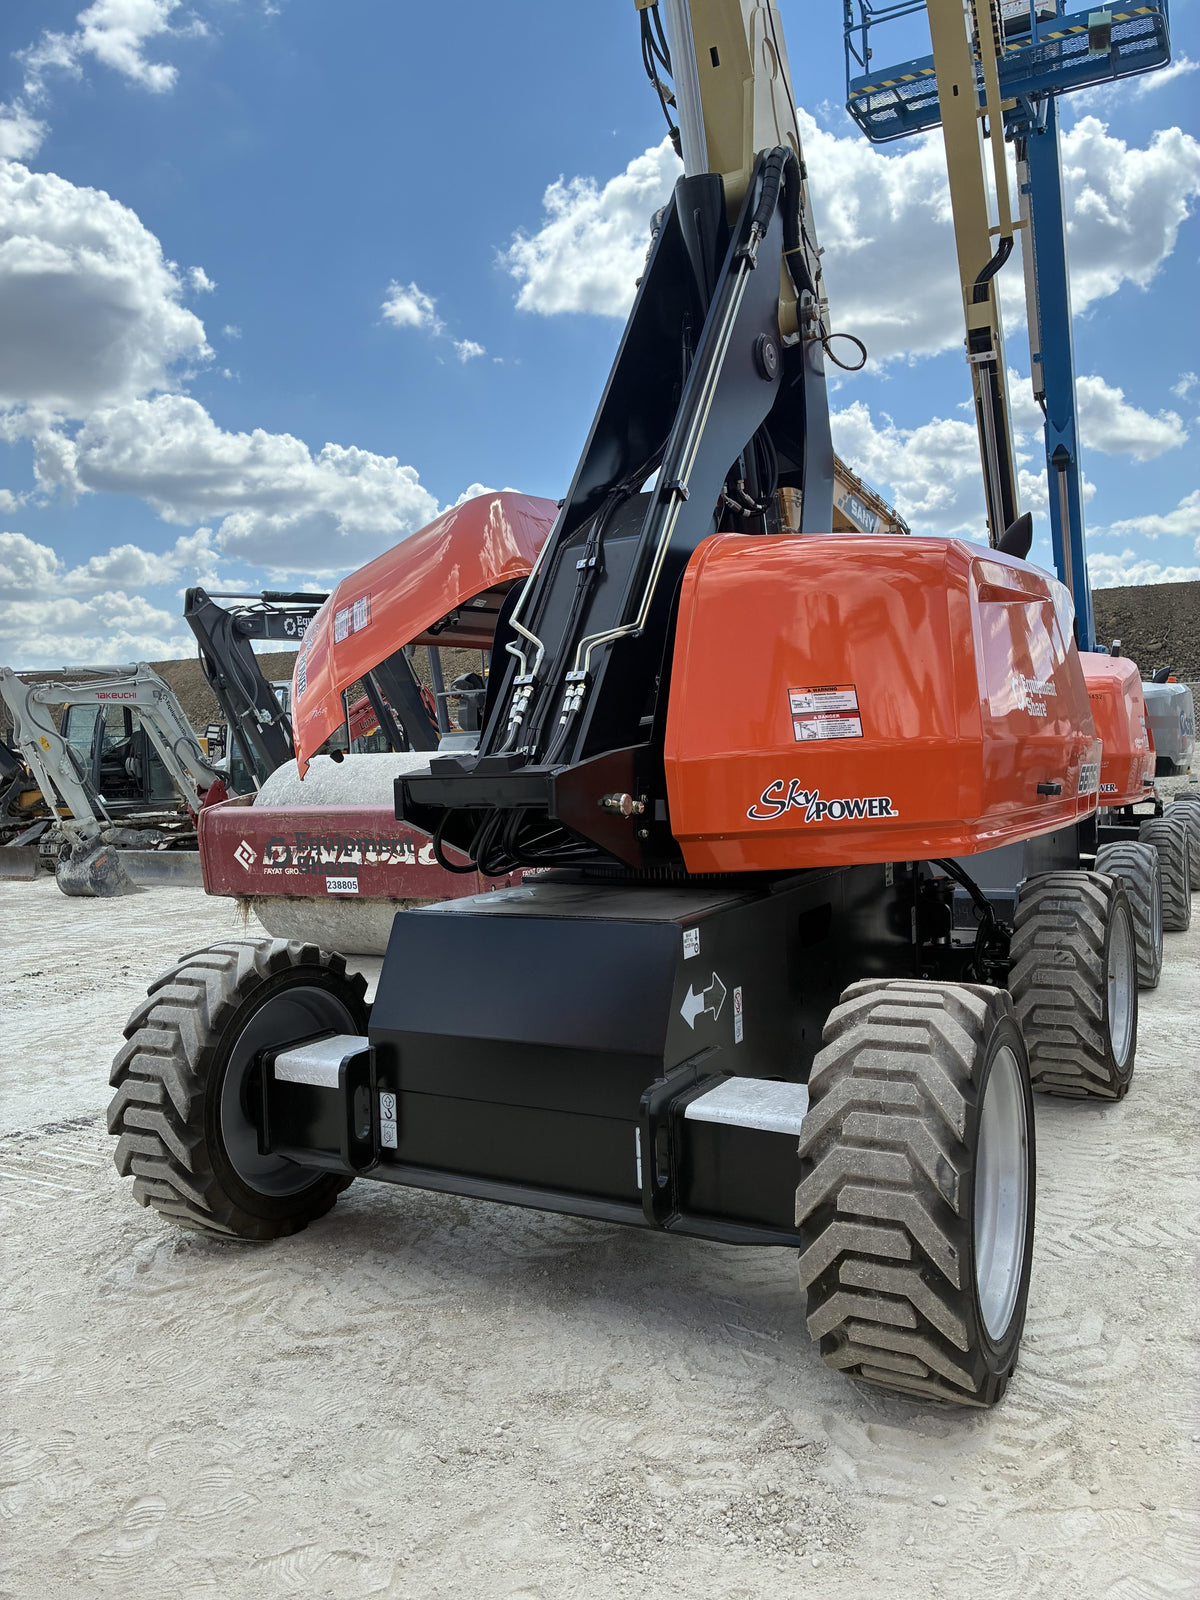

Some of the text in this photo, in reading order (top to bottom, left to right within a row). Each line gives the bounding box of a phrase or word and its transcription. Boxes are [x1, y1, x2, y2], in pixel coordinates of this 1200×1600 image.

[851, 499, 875, 532] SANY
[1020, 673, 1057, 698] Equipment
[1025, 697, 1047, 717] Share
[263, 867, 283, 875] FAYAT
[326, 880, 358, 890] 238805
